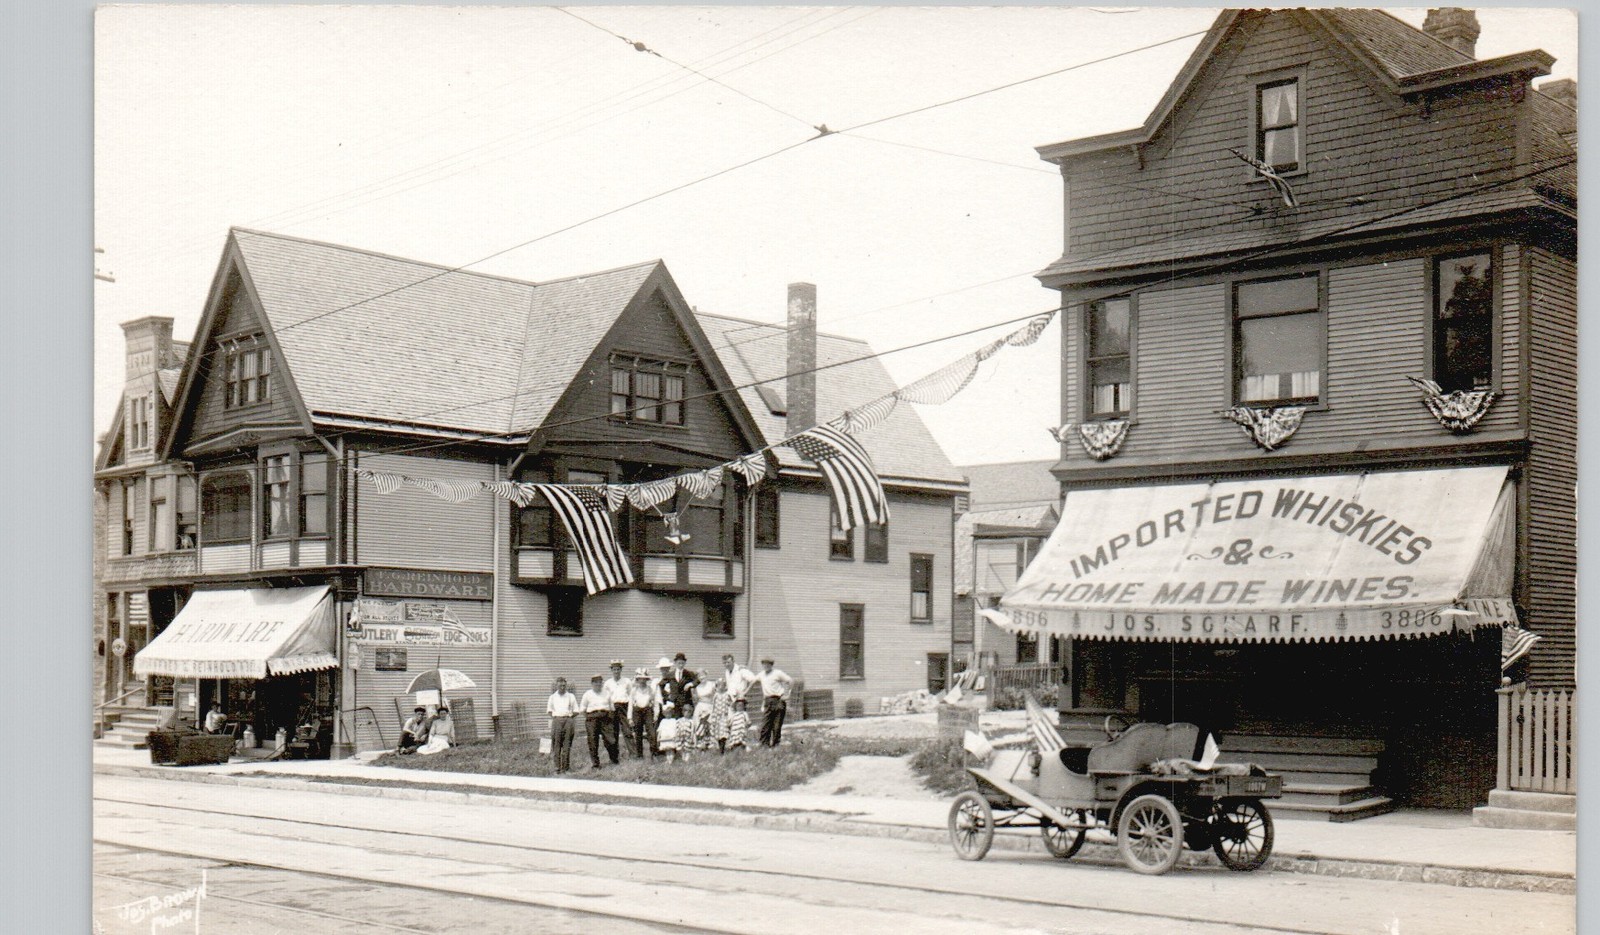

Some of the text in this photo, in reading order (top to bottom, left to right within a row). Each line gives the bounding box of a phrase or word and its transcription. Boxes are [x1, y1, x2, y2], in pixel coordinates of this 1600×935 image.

[1069, 487, 1433, 579] IMPORTED WHISKIES
[1222, 537, 1254, 566] &
[370, 581, 488, 597] HARDWARE
[1040, 576, 1420, 605] HOME MADE WINES.
[1104, 614, 1162, 632] JOS.
[1381, 609, 1443, 630] 3806
[167, 621, 284, 644] HARDWARE
[357, 627, 399, 641] UTLERY
[443, 630, 461, 642] EDGE
